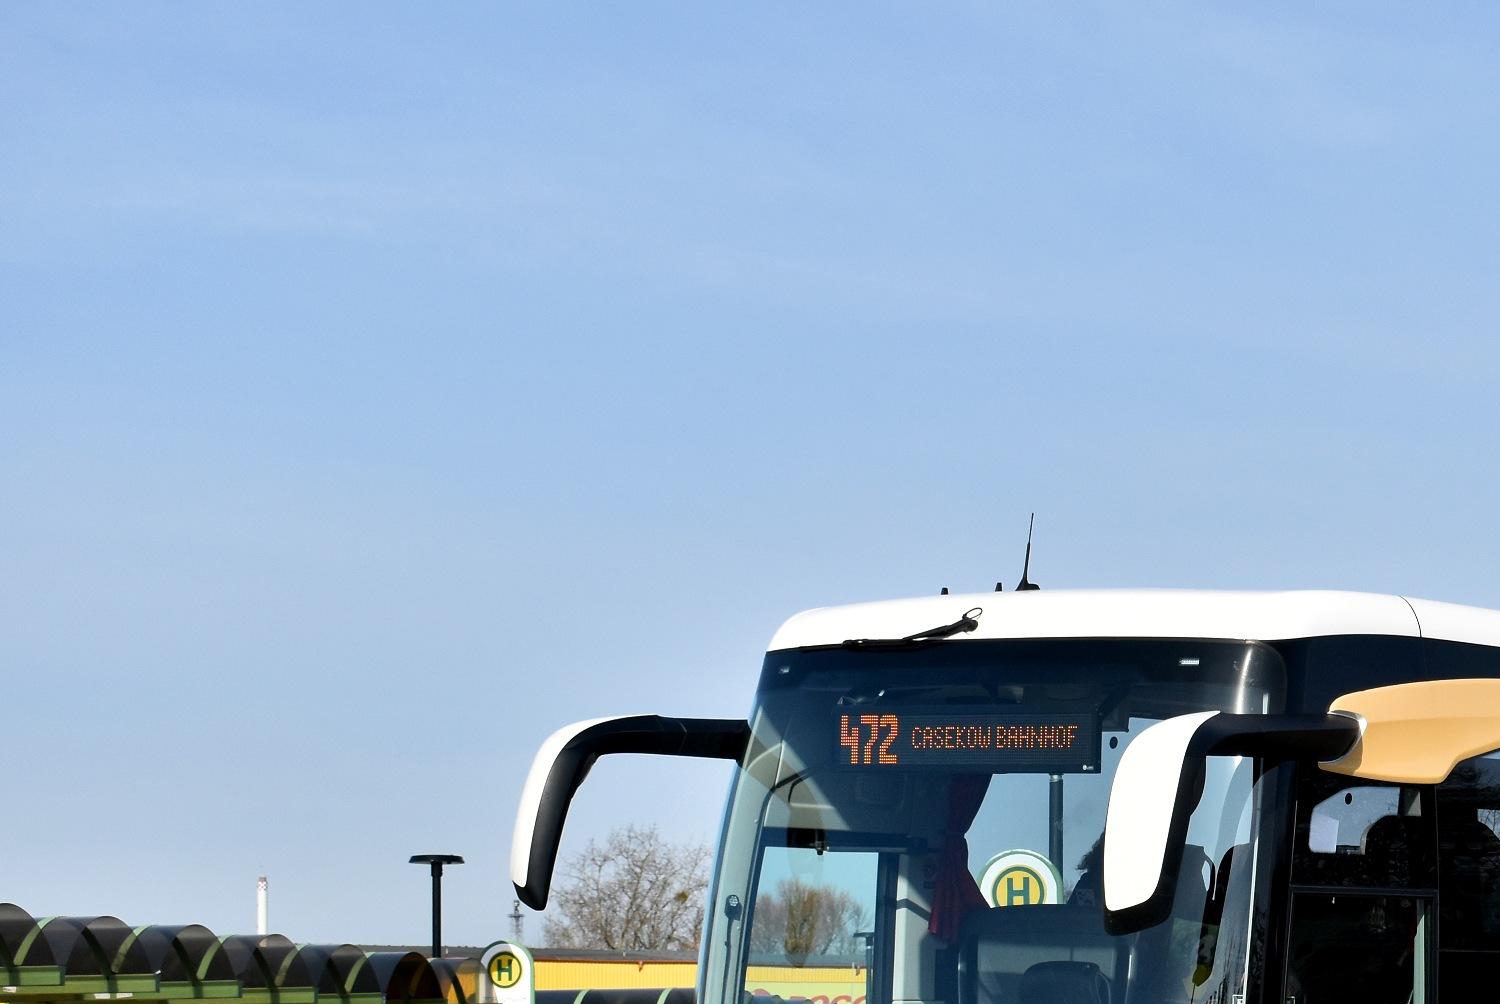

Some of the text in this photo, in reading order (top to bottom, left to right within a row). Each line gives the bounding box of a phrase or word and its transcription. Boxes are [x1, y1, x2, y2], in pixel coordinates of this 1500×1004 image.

[839, 714, 898, 765] 472
[911, 725, 1078, 749] CASEKOW BAHNHOF
[1006, 876, 1030, 906] H
[497, 959, 513, 982] H
